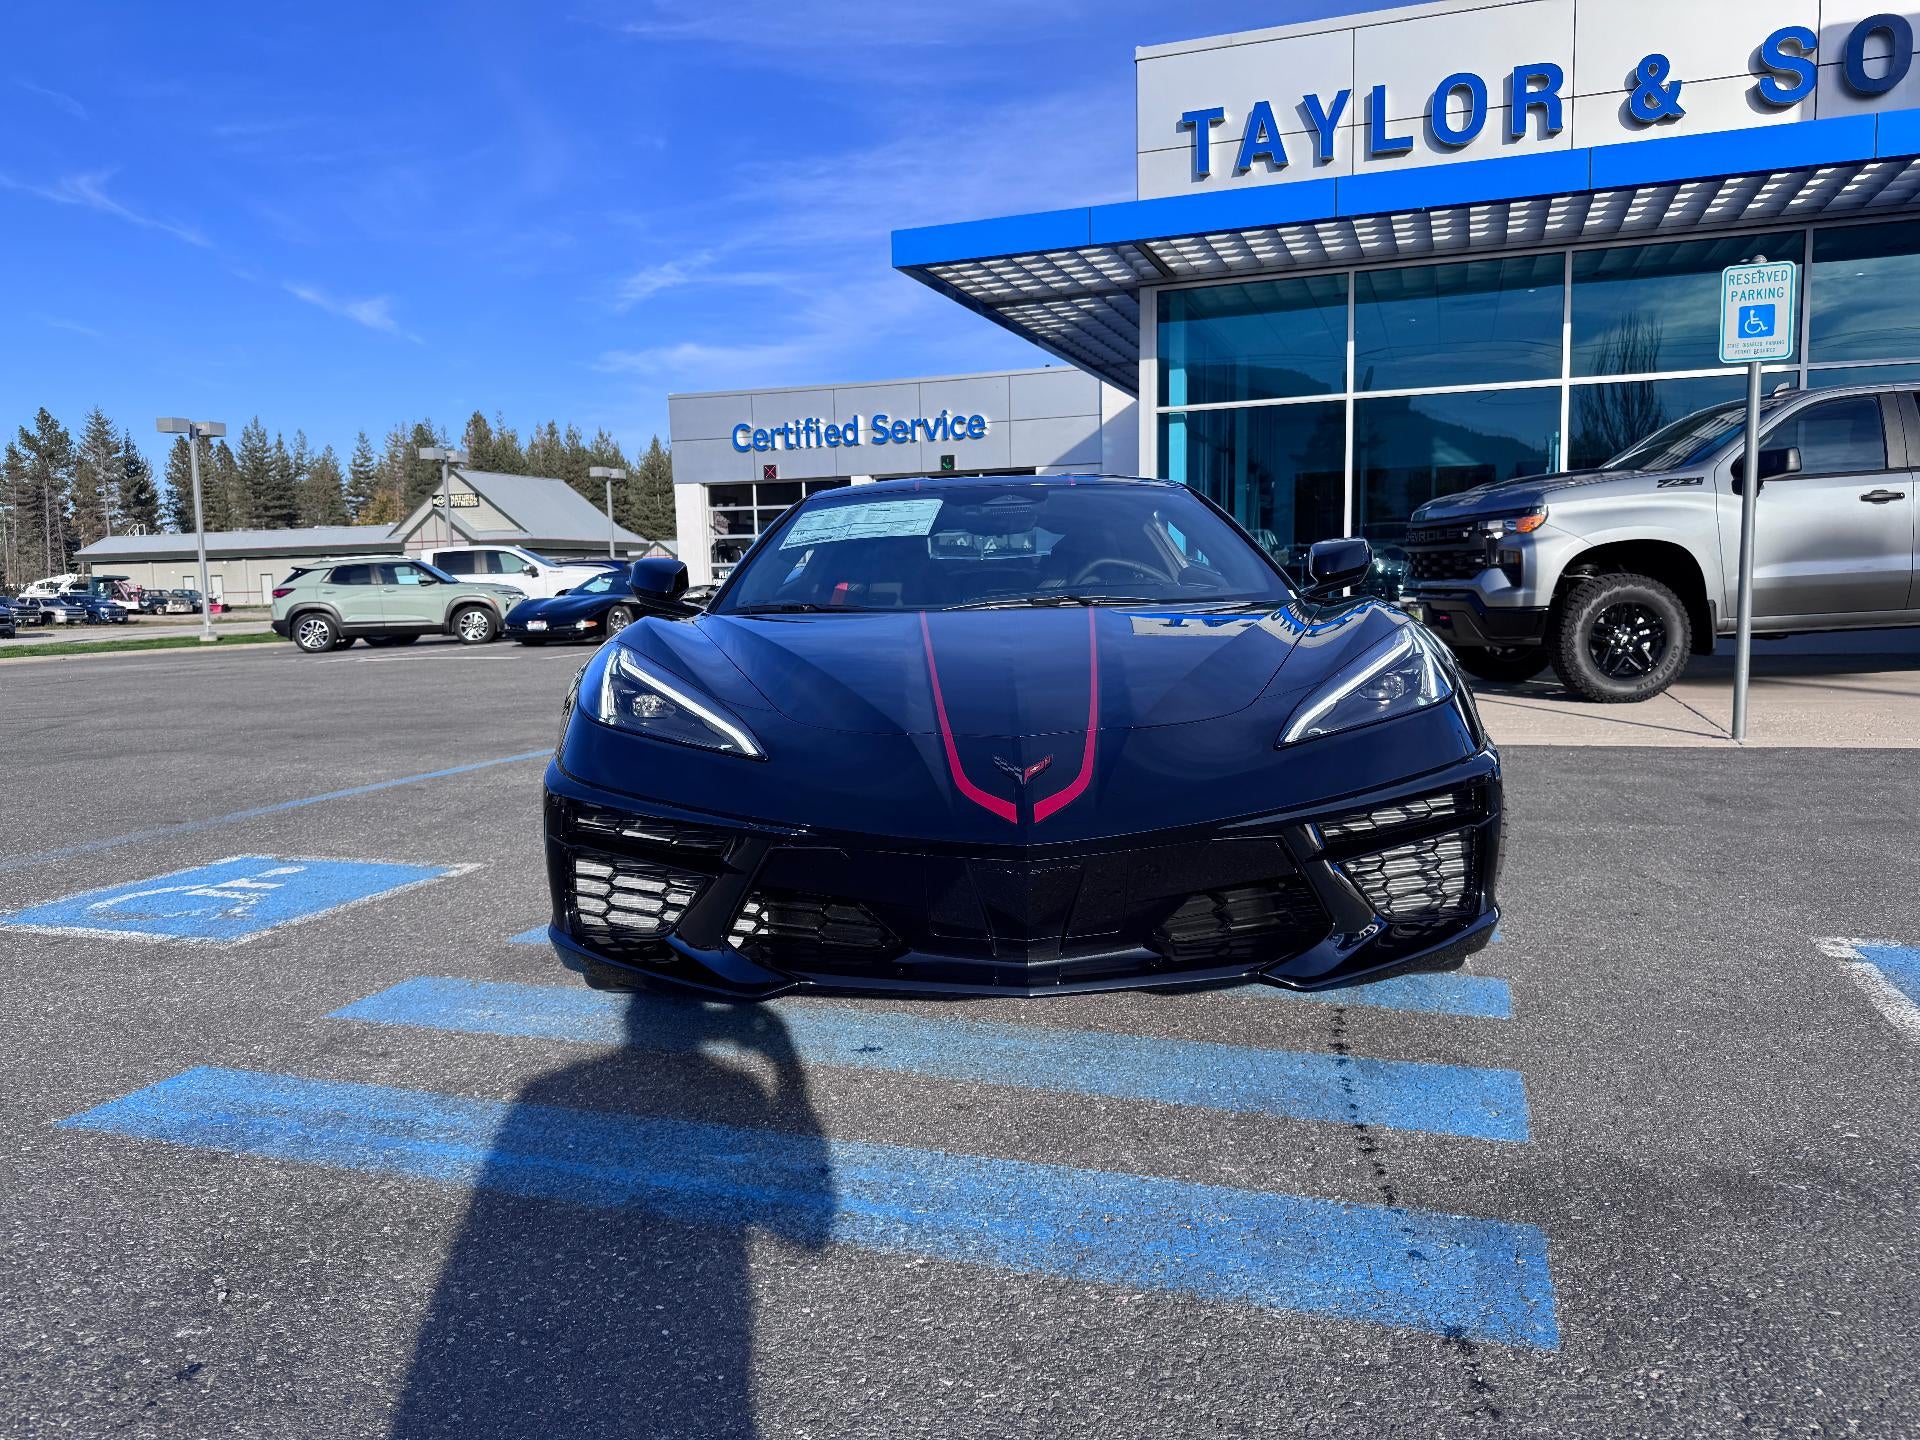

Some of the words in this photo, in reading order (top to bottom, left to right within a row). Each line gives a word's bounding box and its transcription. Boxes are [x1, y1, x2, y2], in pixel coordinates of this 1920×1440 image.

[1181, 62, 1564, 176] TAYLOR
[1630, 53, 1687, 122] &
[1758, 13, 1914, 105] SO
[1728, 269, 1788, 286] RESERVED
[1731, 286, 1784, 302] PARKING
[732, 415, 859, 453] Certified
[871, 409, 986, 445] Service
